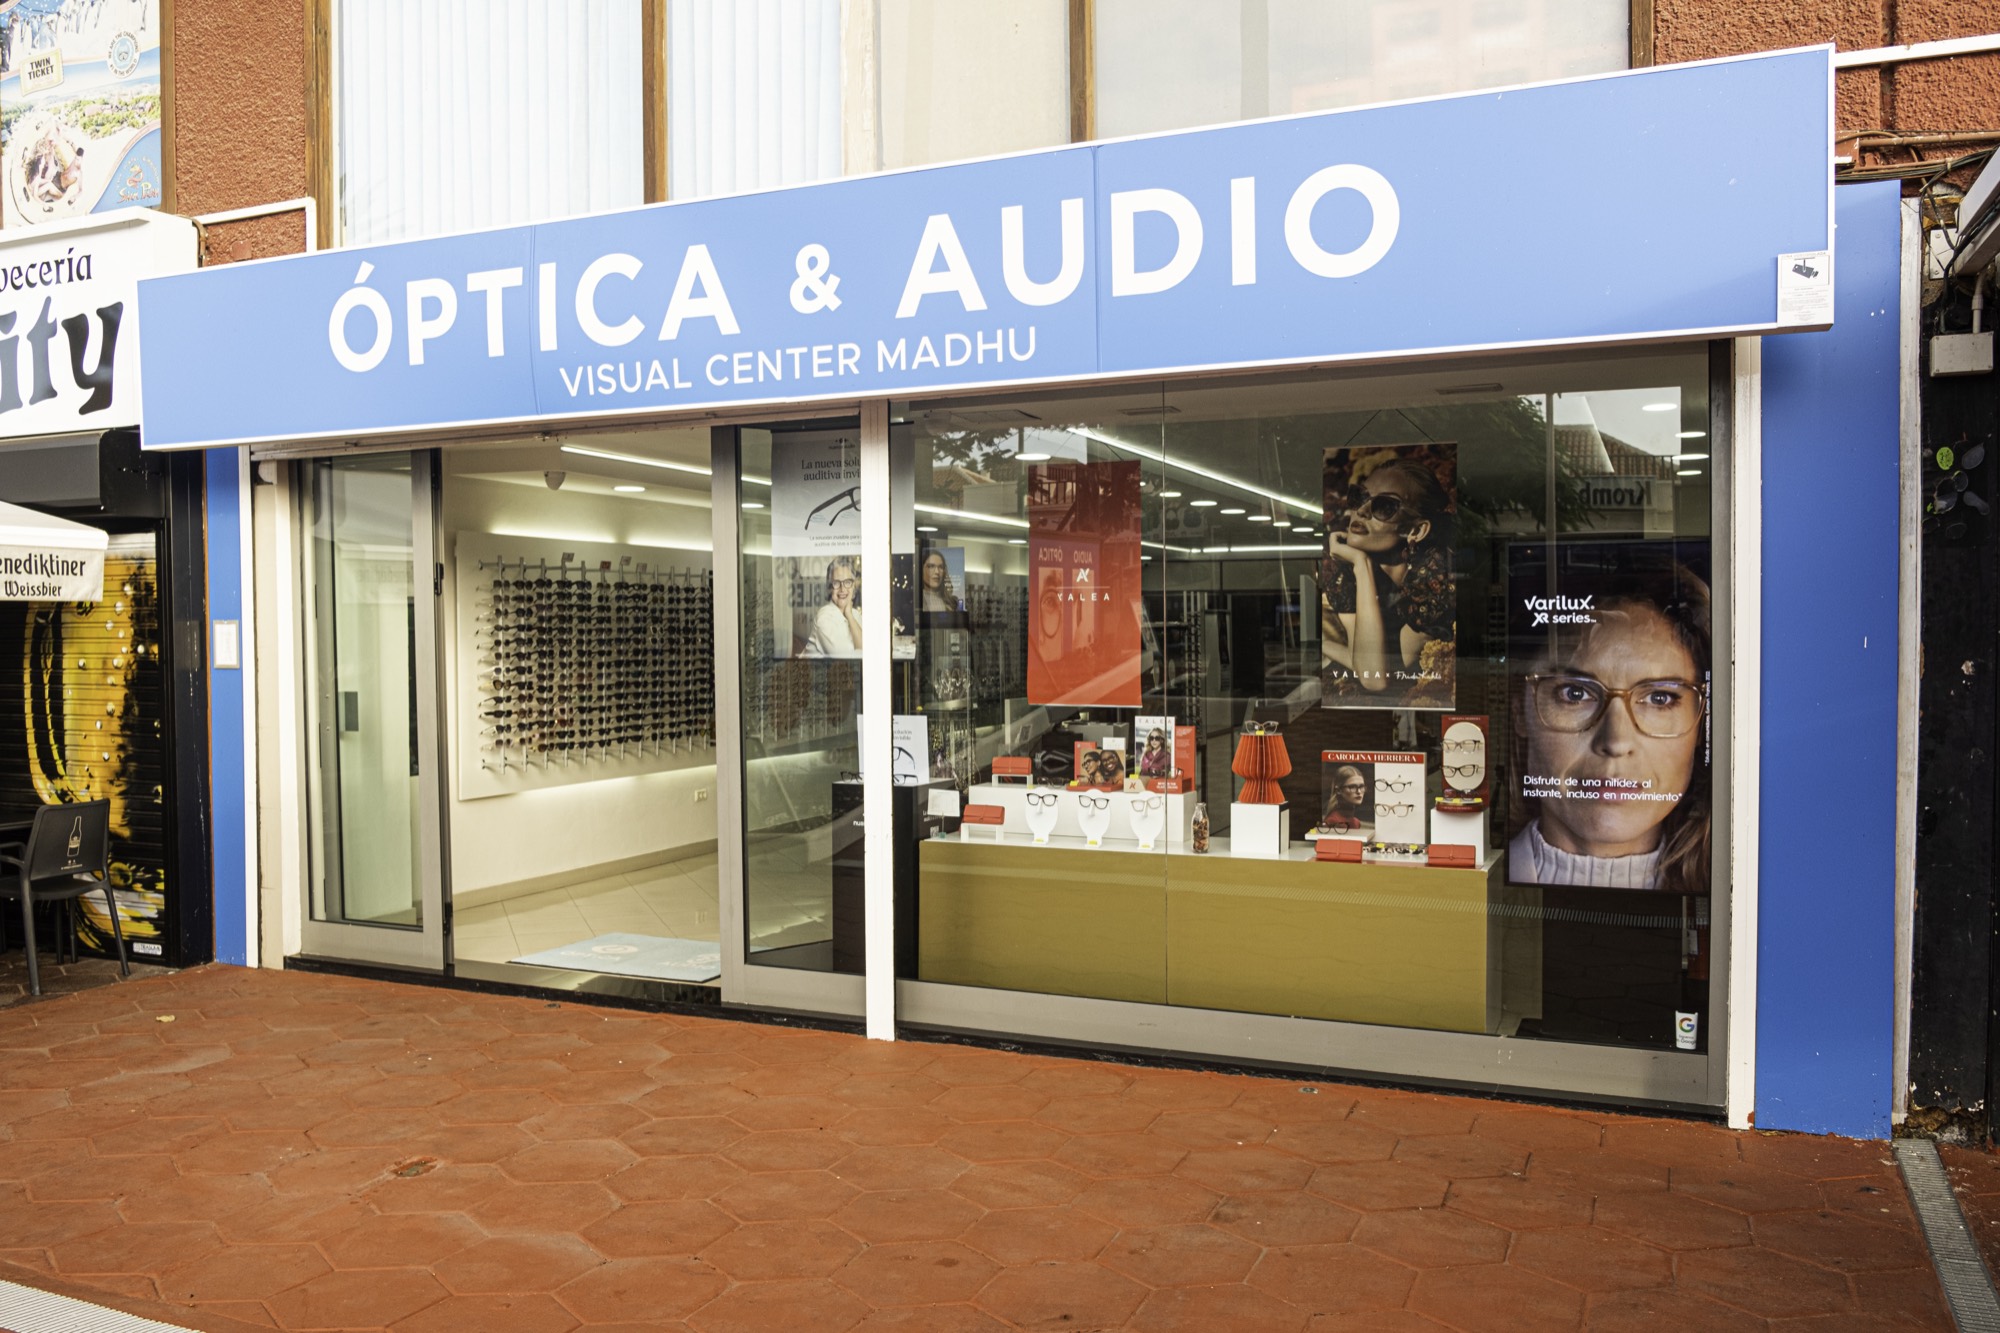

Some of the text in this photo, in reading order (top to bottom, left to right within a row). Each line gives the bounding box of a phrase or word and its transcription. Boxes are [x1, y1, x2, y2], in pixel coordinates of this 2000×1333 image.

[30, 57, 51, 70] TWIN
[28, 65, 54, 80] TICKET
[328, 163, 1400, 373] ÓPTICA & AUDIO
[559, 325, 1037, 398] VISUAL CENTER MADHU
[801, 460, 813, 470] La
[814, 460, 842, 469] nueva
[803, 471, 841, 481] auditiva
[0, 553, 86, 578] nediktiner
[4, 580, 62, 597] Weissbier
[1057, 592, 1110, 602] YALEA
[1332, 671, 1381, 679] YALEA
[1328, 753, 1417, 763] CAROLINA HERRERA
[1523, 775, 1652, 788] Disfruta de una nitidez al
[1566, 788, 1600, 799] incluso
[1603, 791, 1616, 800] en
